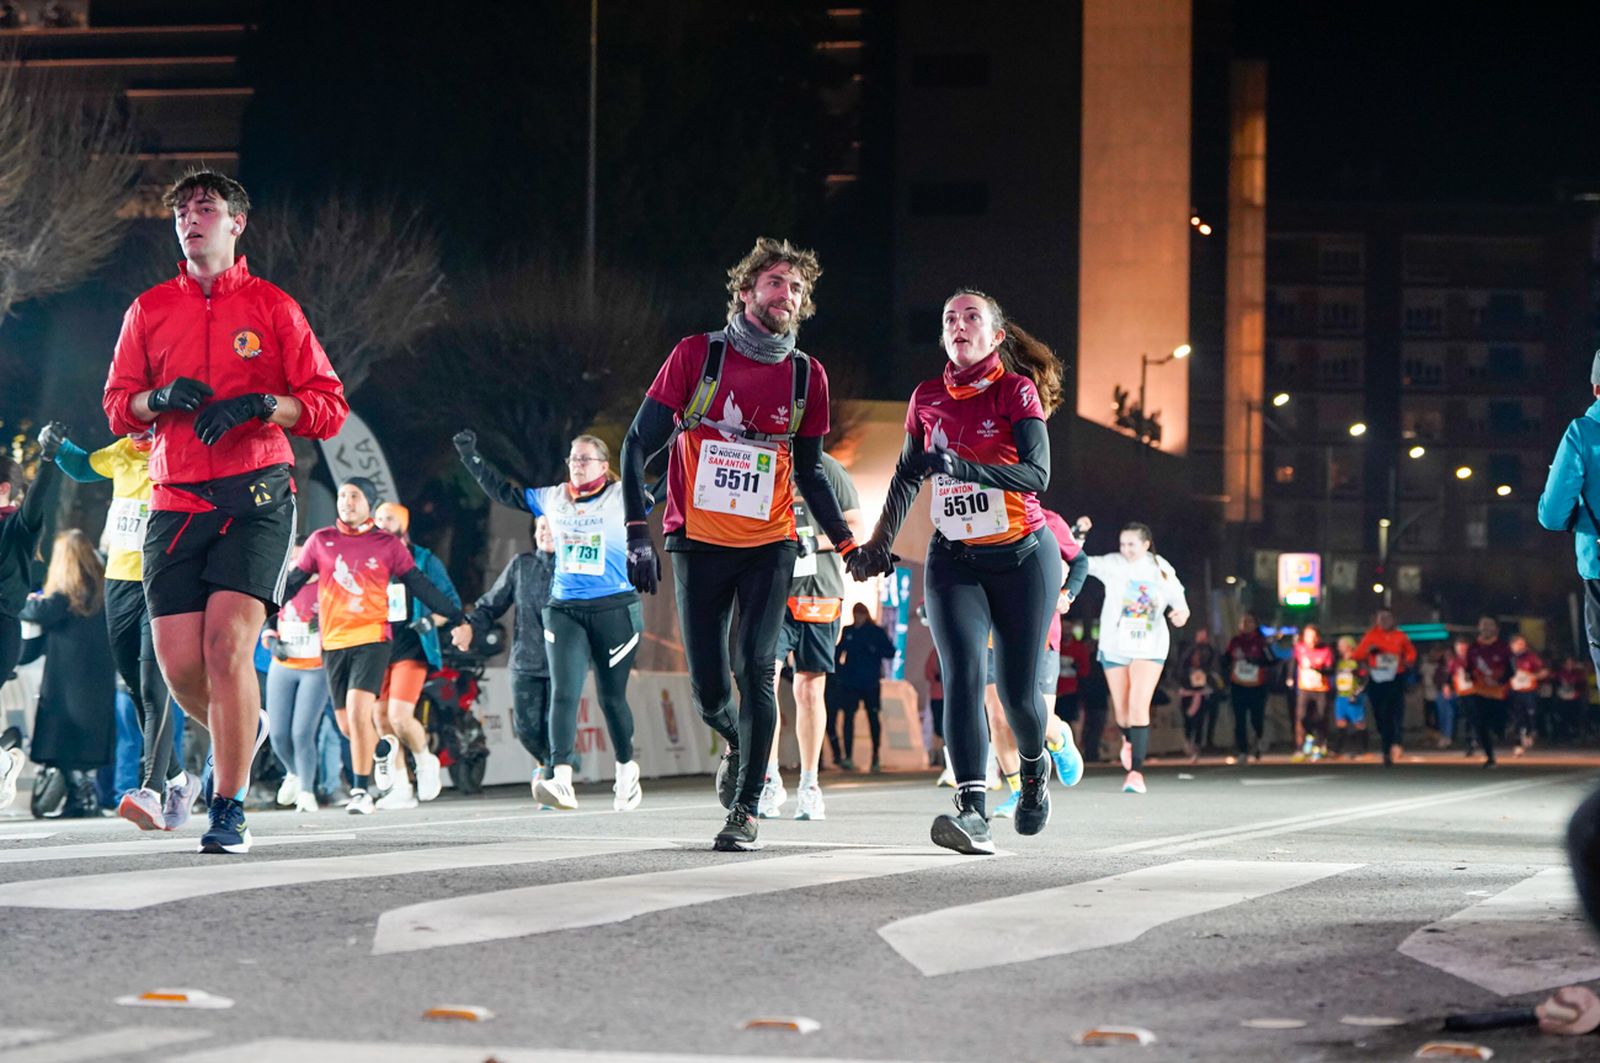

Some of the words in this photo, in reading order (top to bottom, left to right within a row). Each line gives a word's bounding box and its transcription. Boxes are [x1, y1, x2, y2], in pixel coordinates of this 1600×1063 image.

[708, 456, 725, 466] SAN
[718, 450, 741, 459] NOCHE
[742, 453, 751, 461] DE
[714, 467, 760, 493] 5511
[938, 487, 951, 497] SAN
[943, 491, 990, 517] 5510
